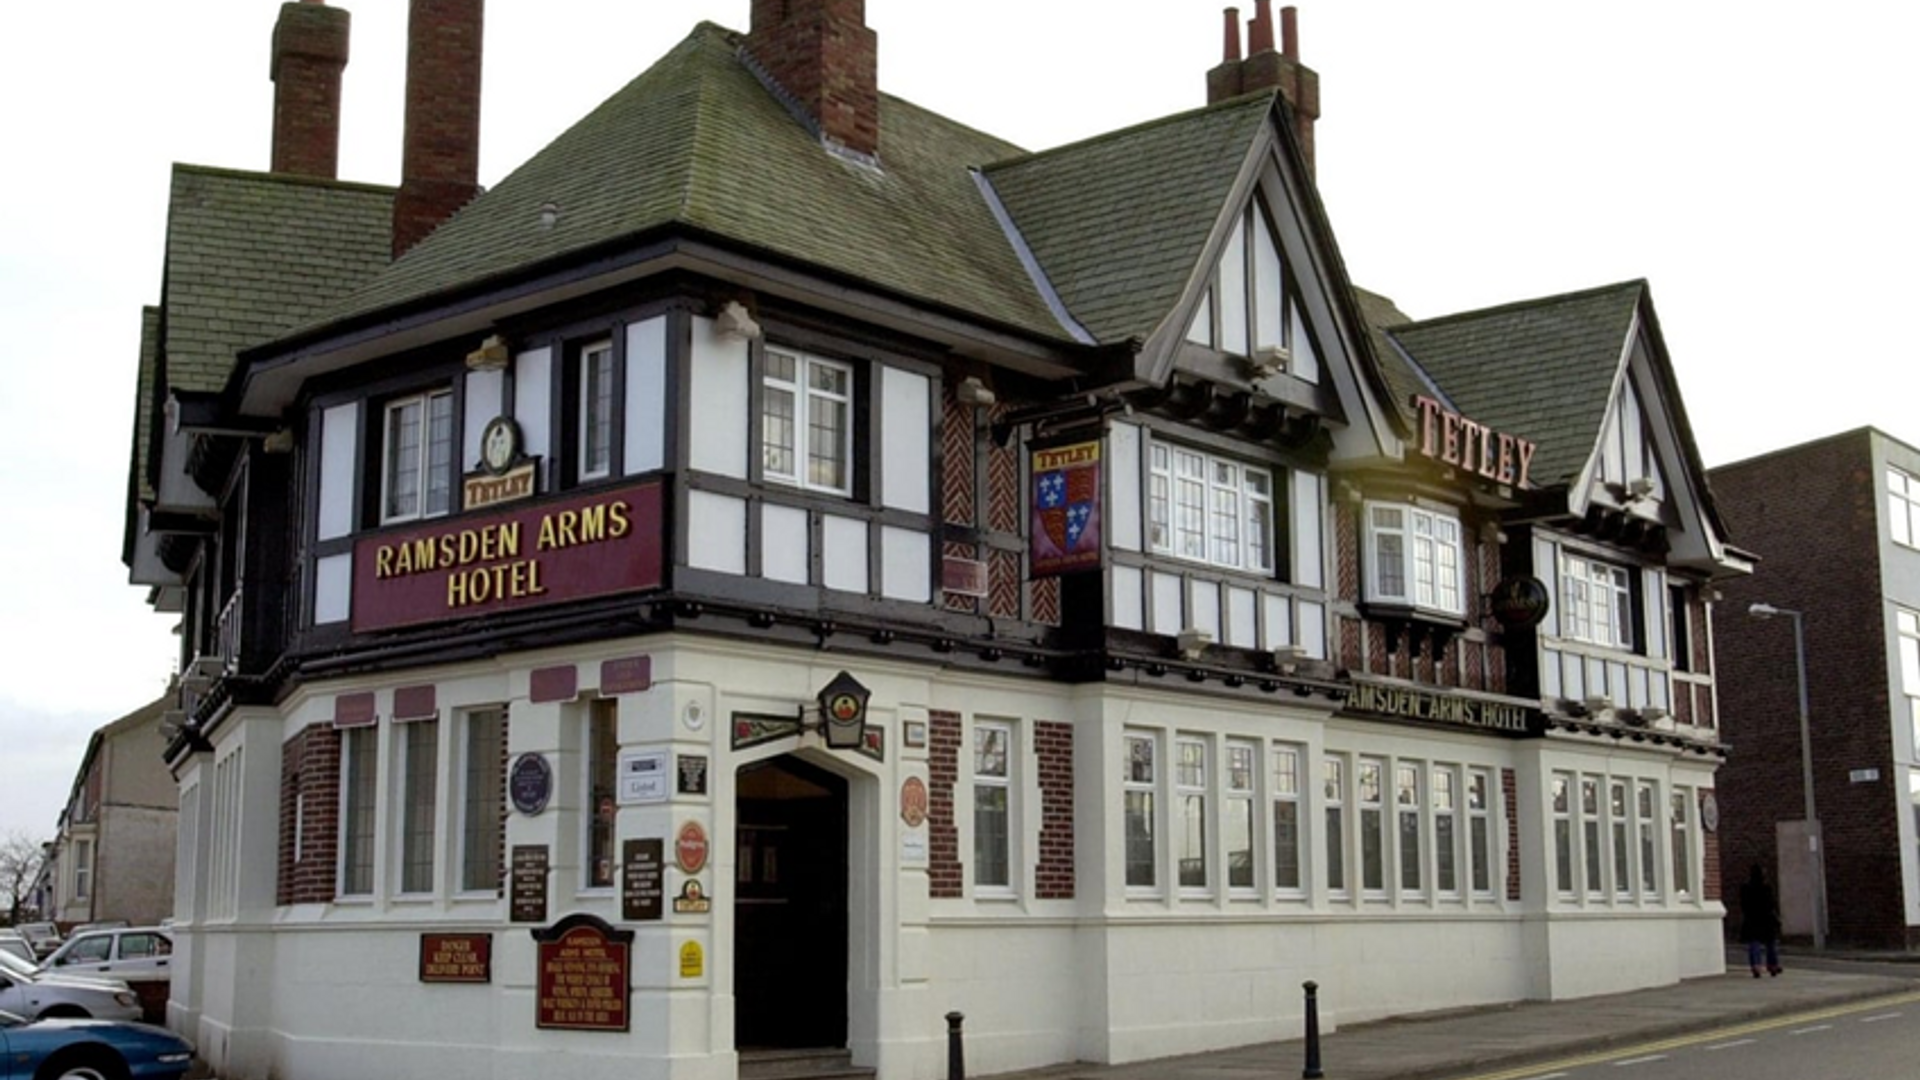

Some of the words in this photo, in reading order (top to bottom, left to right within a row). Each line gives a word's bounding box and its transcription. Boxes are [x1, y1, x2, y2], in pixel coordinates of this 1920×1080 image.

[1037, 444, 1095, 467] TETLEY
[1416, 395, 1537, 490] TETLEY
[467, 472, 531, 505] TETLEY
[375, 521, 521, 578] RAMSDEN
[537, 501, 630, 550] ARMS
[447, 560, 545, 606] HOTEL
[1346, 684, 1421, 717] AMSDEN
[1429, 694, 1474, 724] ARMS
[1480, 701, 1527, 731] HOTEL
